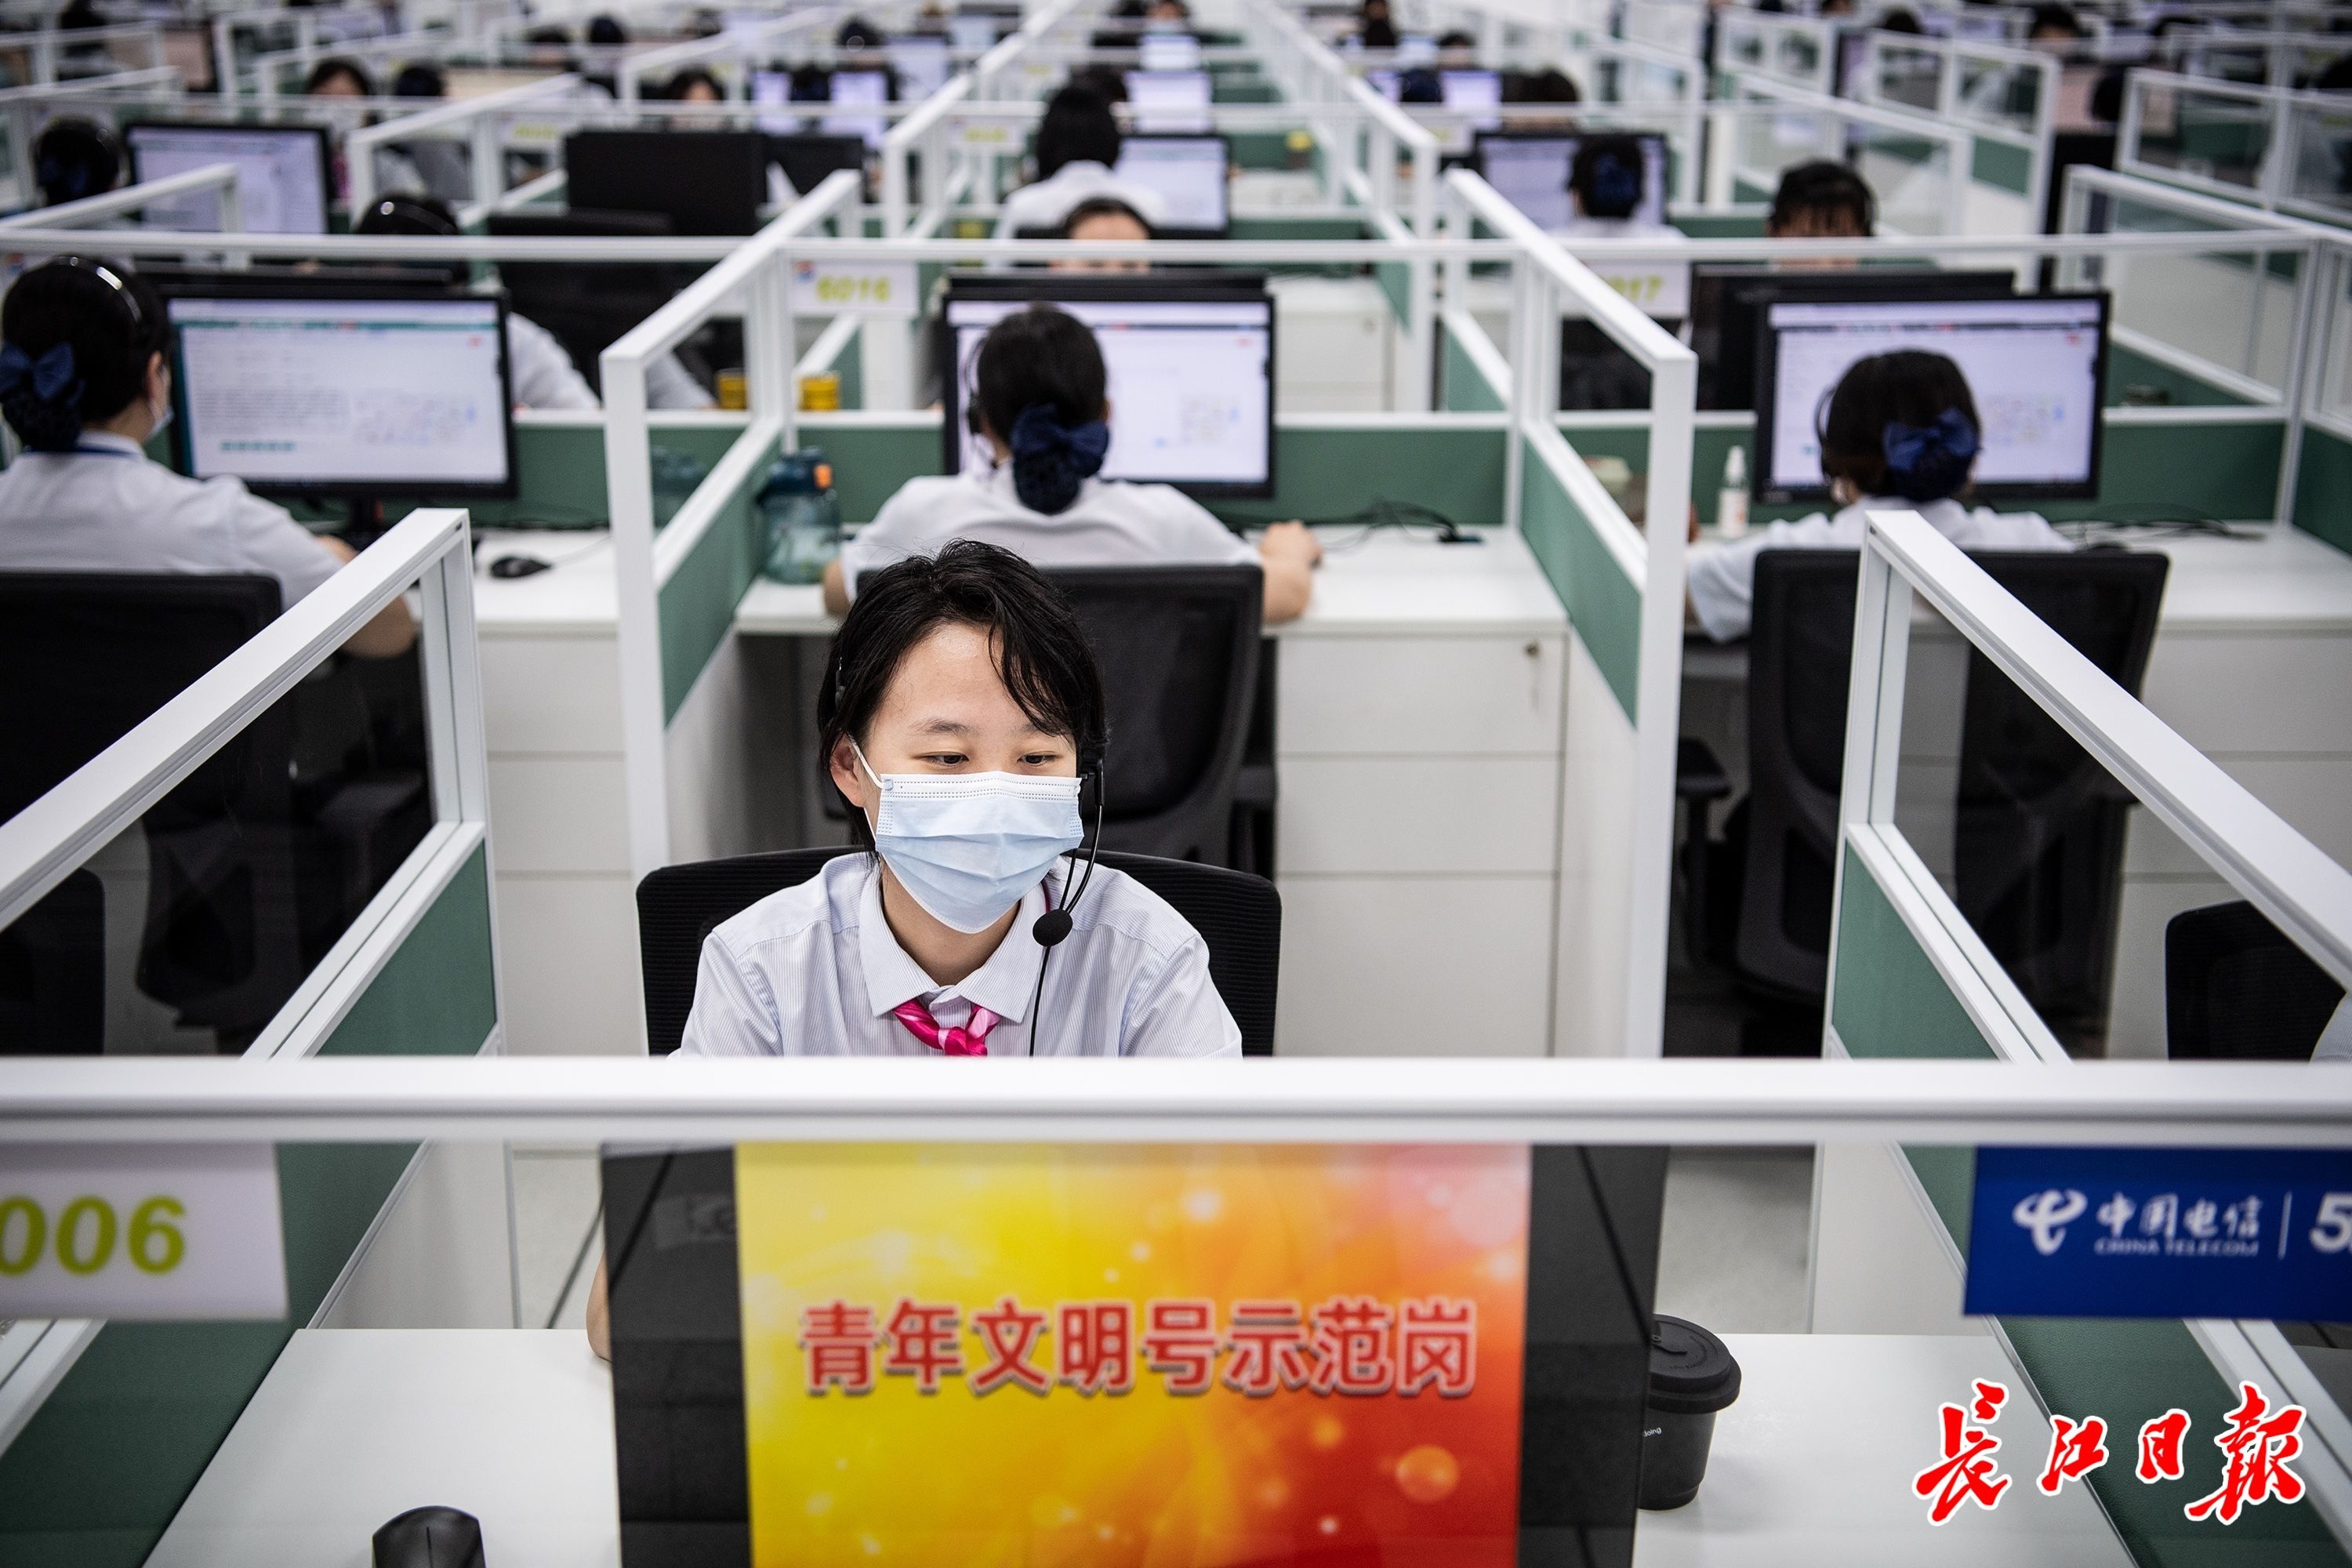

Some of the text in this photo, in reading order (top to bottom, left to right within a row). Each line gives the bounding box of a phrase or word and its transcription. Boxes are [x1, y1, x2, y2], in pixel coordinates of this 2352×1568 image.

[2096, 1191, 2263, 1240] 中国电信
[2093, 1237, 2259, 1256] CHINA TELECOM
[800, 1298, 1479, 1396] 青年文明号示范岗
